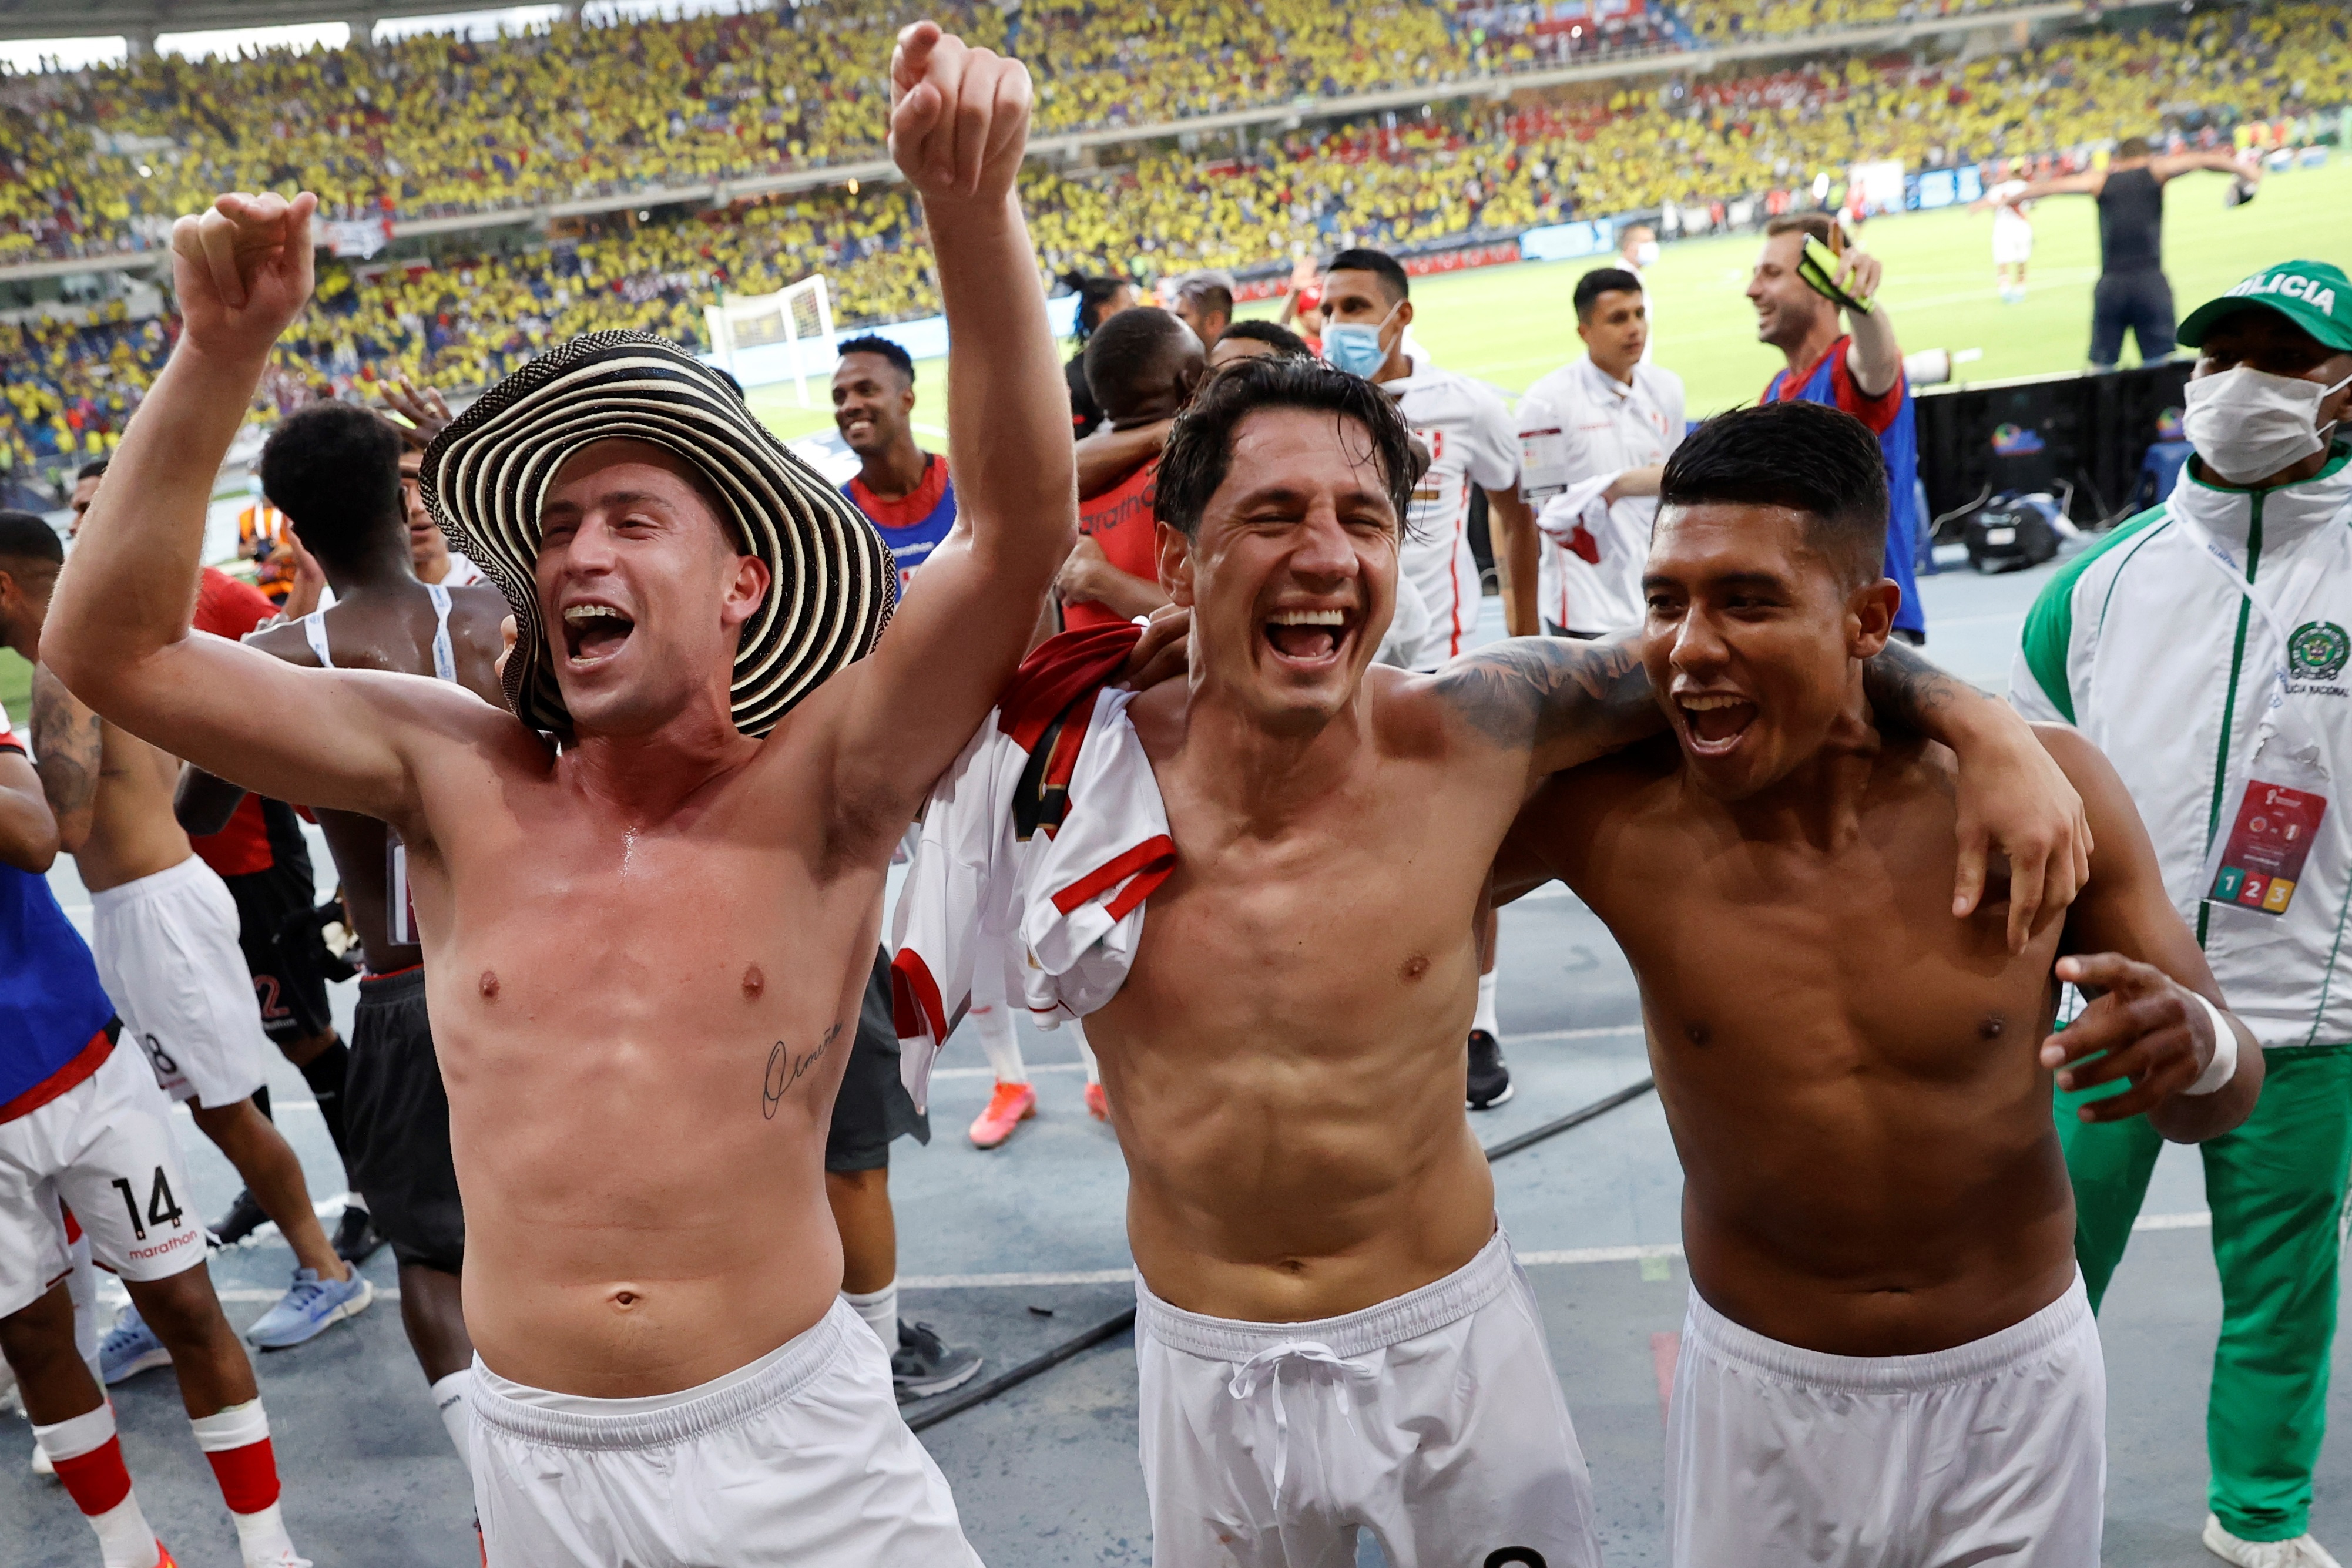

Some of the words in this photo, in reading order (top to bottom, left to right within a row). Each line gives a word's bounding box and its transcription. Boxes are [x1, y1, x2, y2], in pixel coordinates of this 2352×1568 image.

[2223, 273, 2336, 317] OLICIA
[1079, 484, 1157, 535] aratho
[2225, 875, 2236, 891] 1
[2245, 881, 2262, 898] 2
[2270, 887, 2286, 903] 3
[112, 1165, 183, 1241] 14
[129, 1230, 198, 1260] marathon
